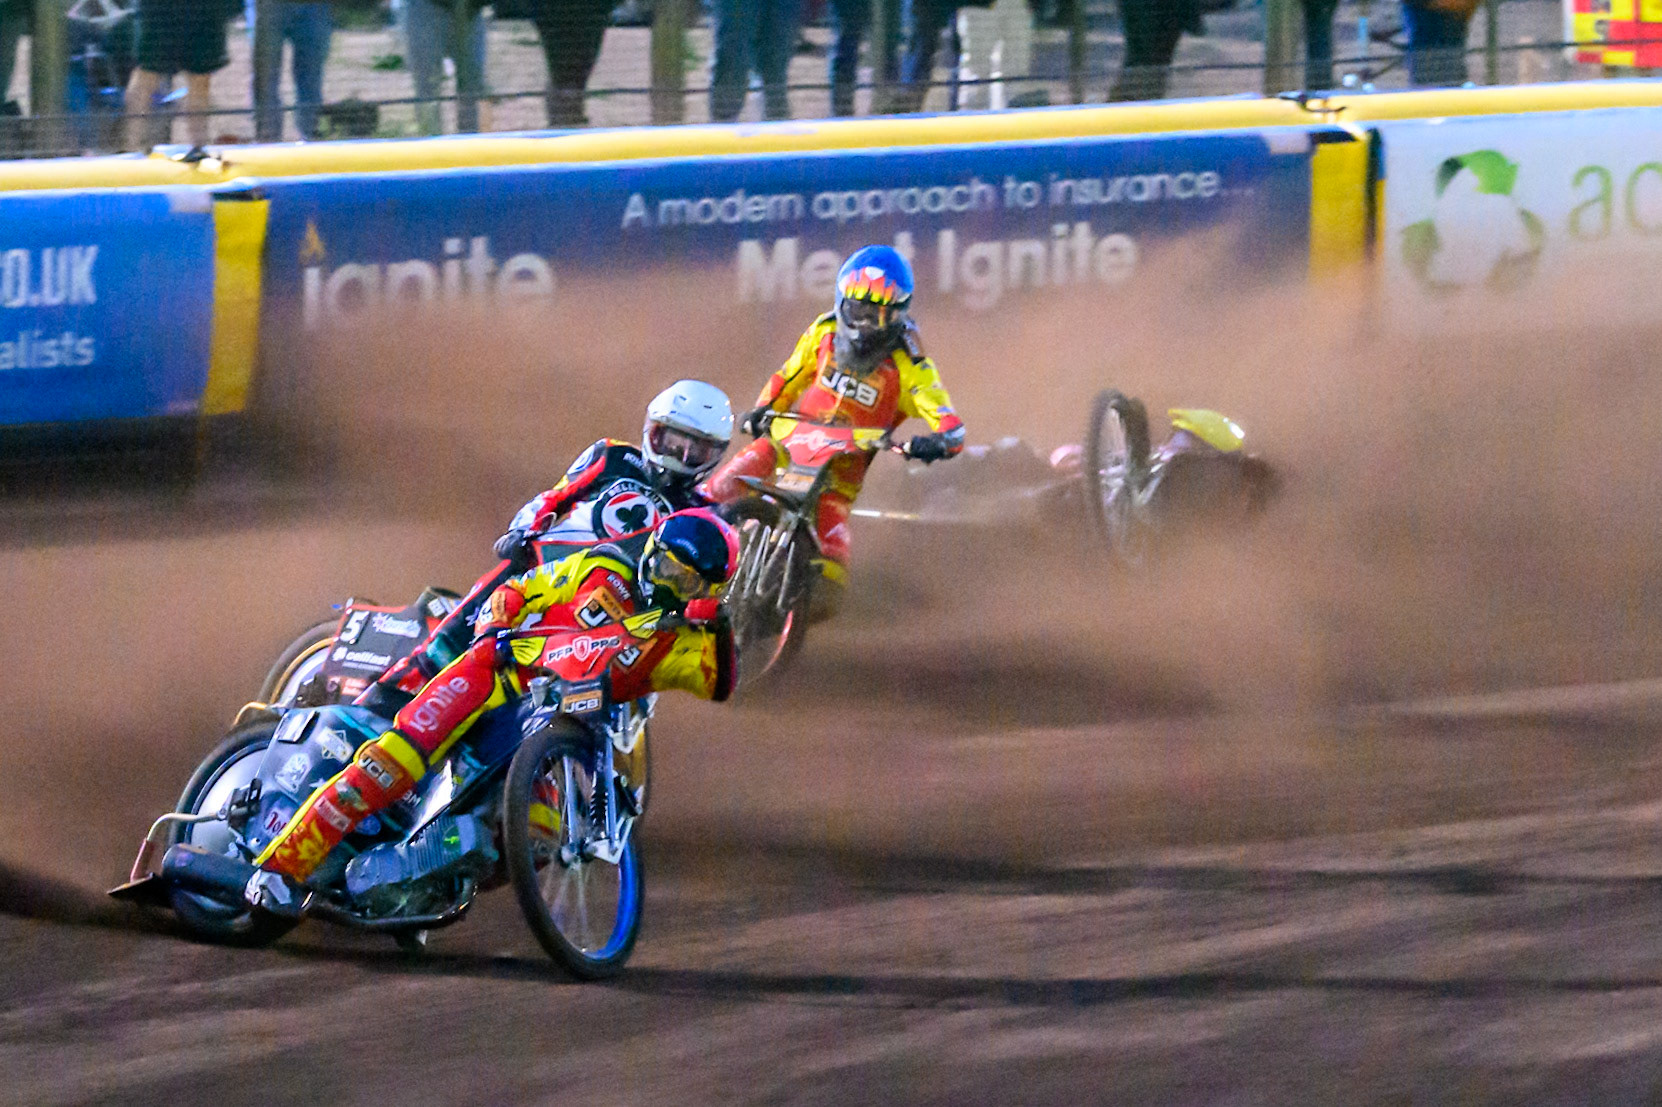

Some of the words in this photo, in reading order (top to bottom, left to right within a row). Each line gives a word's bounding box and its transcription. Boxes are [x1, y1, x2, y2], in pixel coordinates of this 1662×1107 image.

[622, 193, 649, 228] A
[657, 189, 804, 225] modern
[812, 178, 996, 224] approach
[1003, 175, 1041, 207] to
[937, 221, 1138, 312] Ignite
[821, 371, 879, 407] JCB
[606, 573, 632, 600] ROWE
[339, 611, 370, 644] 5
[547, 647, 574, 661] PFP
[564, 698, 600, 714] JCB
